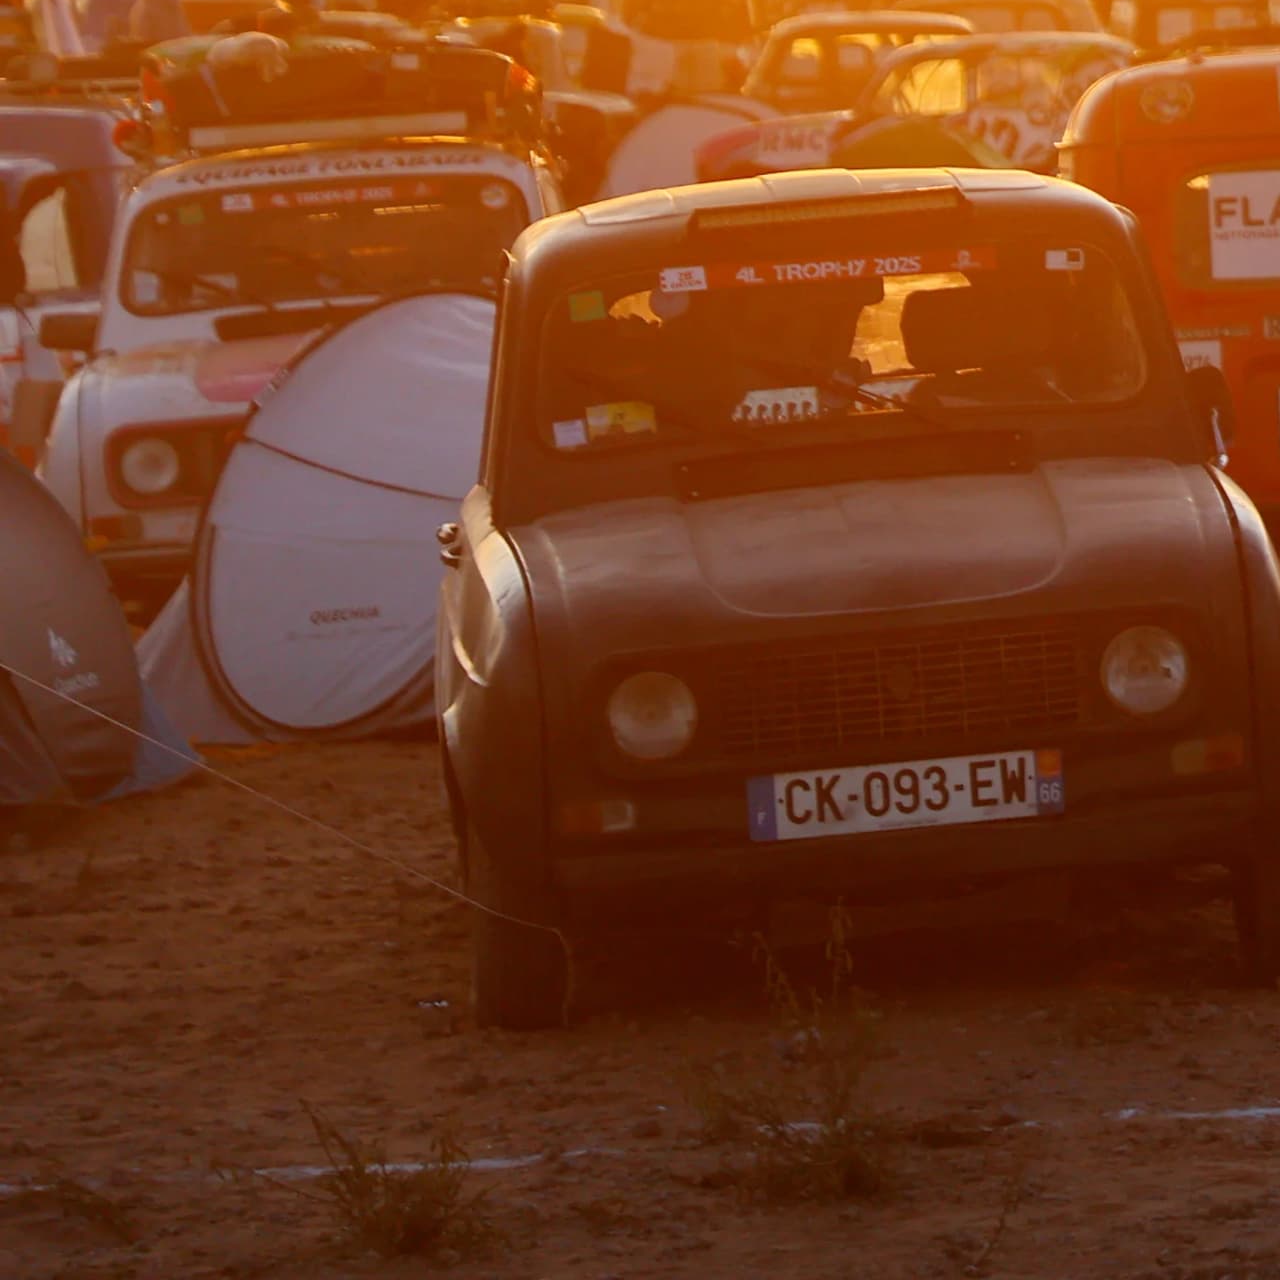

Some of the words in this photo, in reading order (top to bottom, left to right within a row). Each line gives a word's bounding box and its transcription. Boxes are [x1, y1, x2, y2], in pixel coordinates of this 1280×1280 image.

[735, 267, 765, 283] 4L
[773, 259, 866, 281] TROPHY
[874, 255, 922, 275] 2025
[784, 756, 1027, 825] CK-093-EW
[1039, 782, 1061, 804] 66
